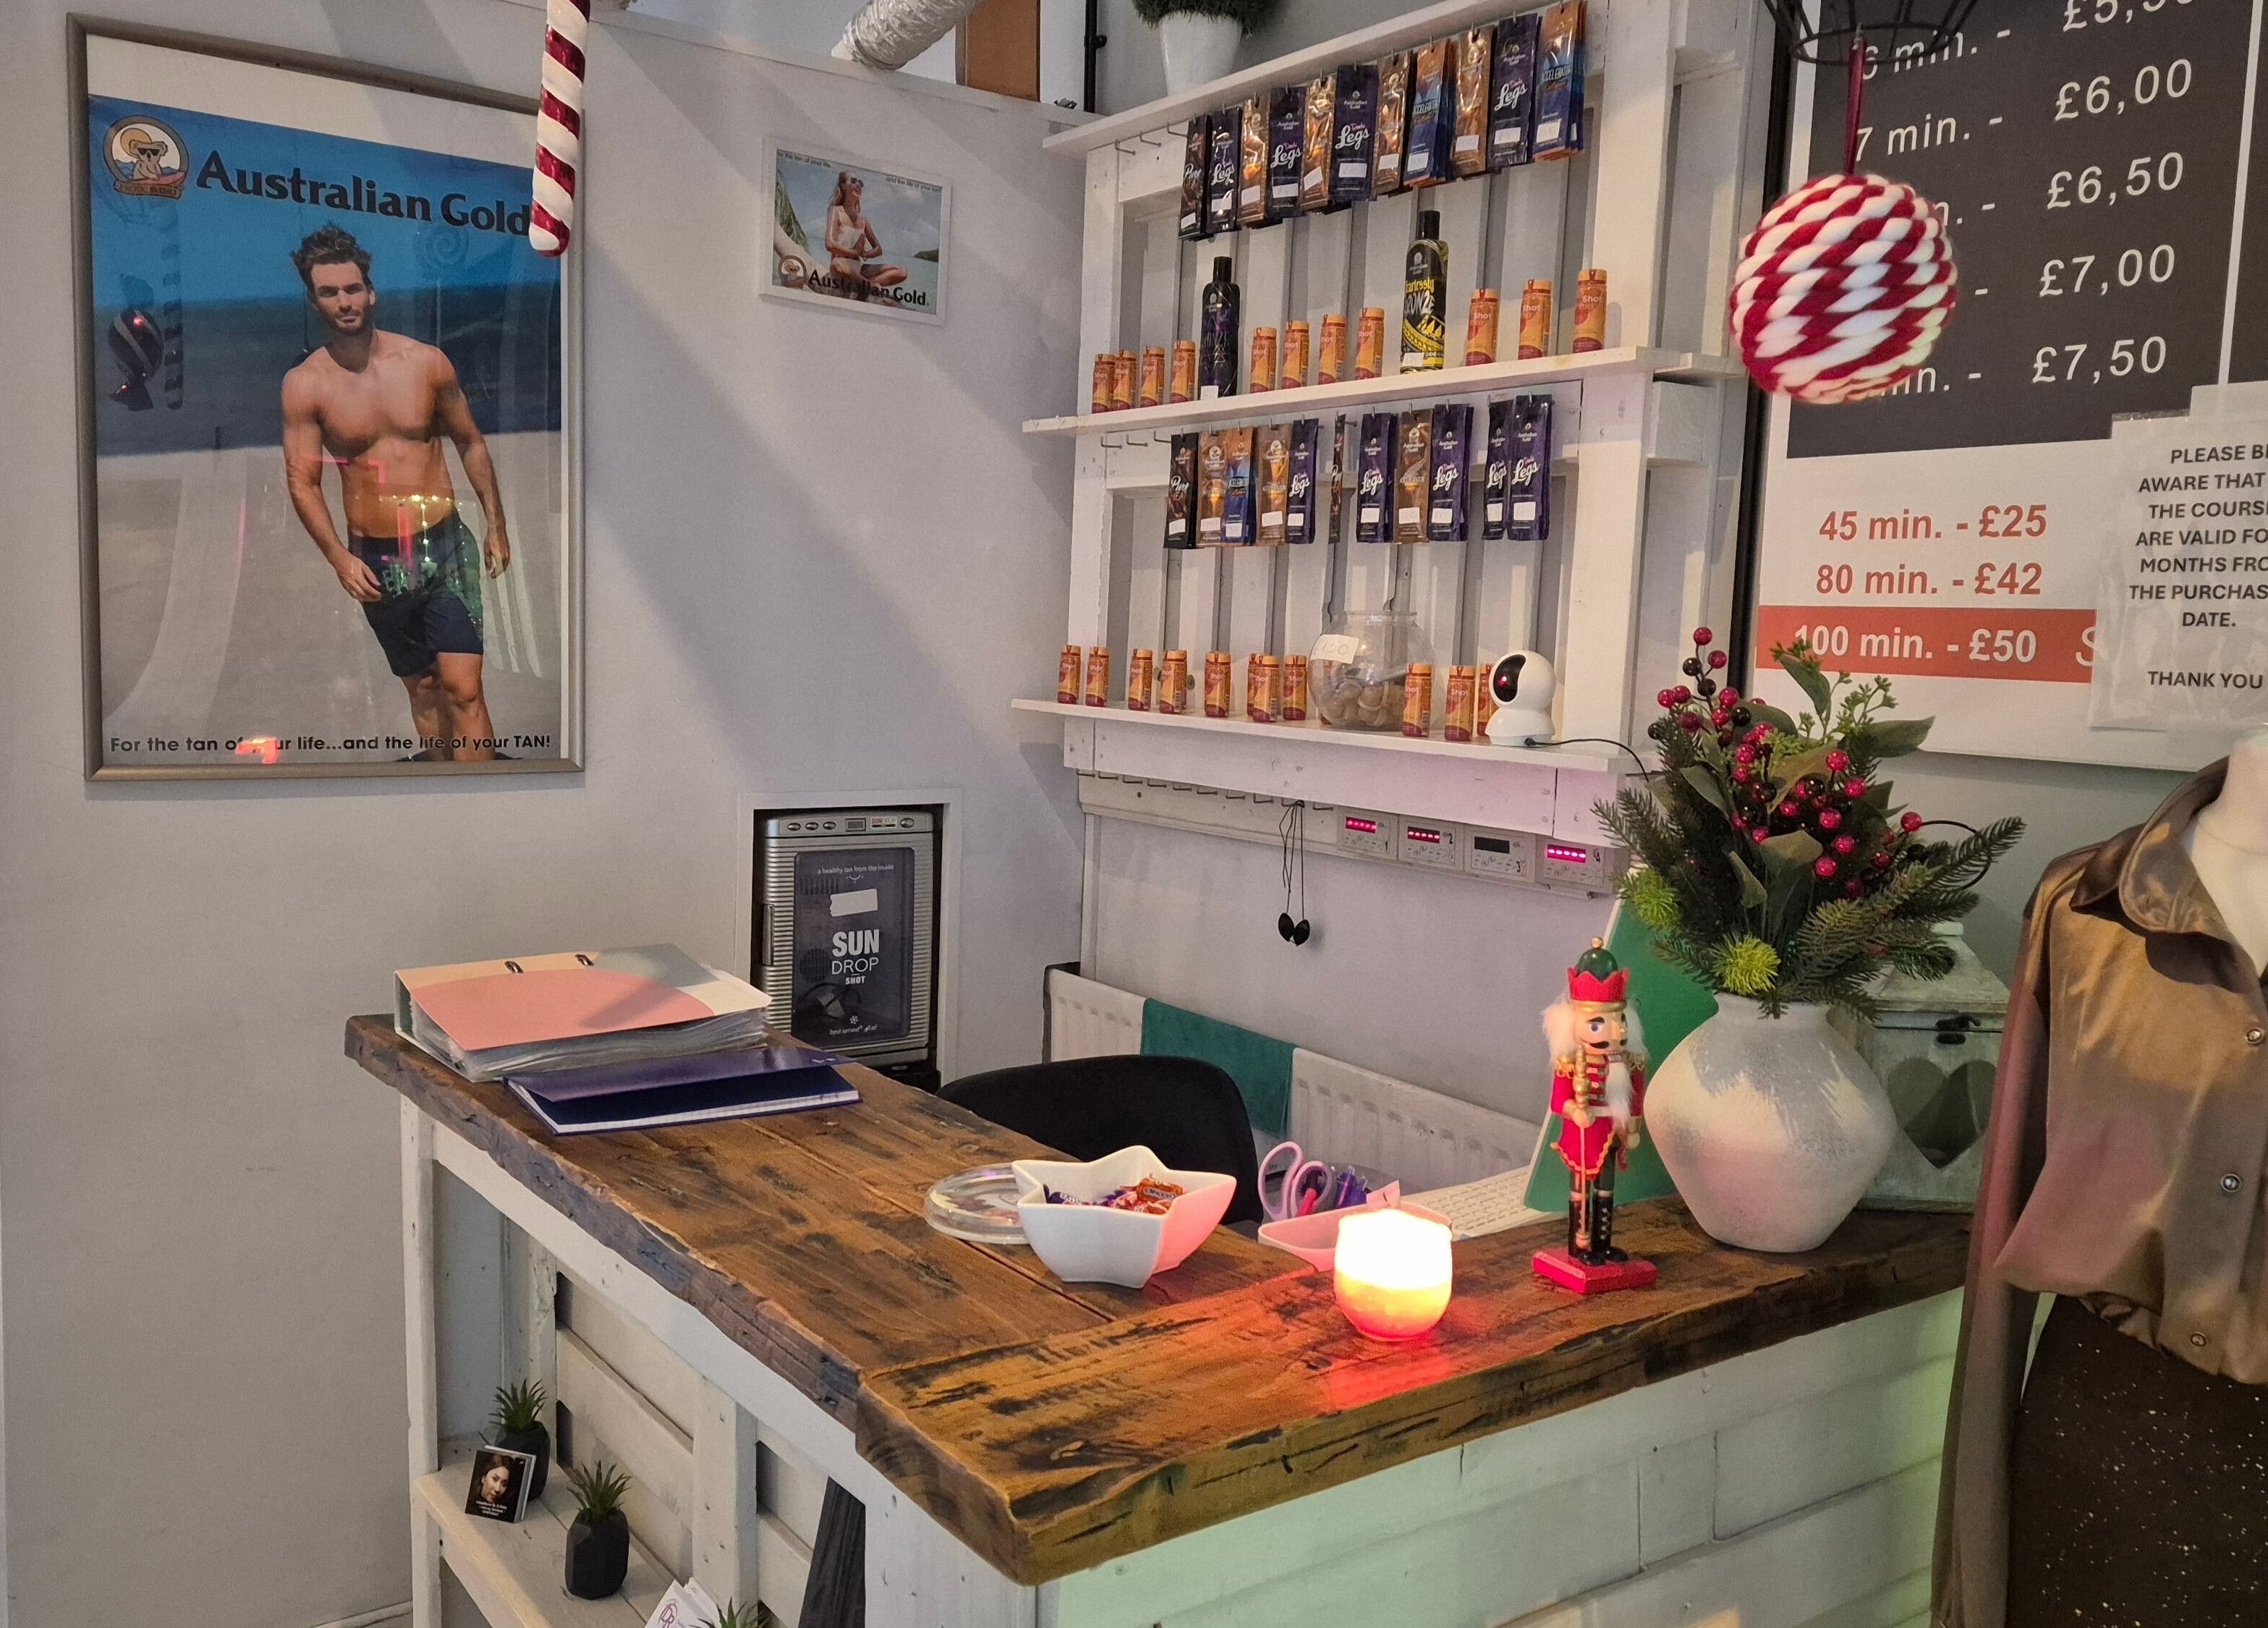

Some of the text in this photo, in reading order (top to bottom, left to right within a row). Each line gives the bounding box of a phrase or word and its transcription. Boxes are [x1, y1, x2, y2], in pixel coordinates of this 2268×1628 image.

[2063, 0, 2194, 32] £5,
[1494, 82, 1528, 111] Legs
[1855, 126, 1874, 162] 7
[1887, 113, 1970, 156] min.
[2055, 59, 2192, 122] £6,00
[1335, 124, 1370, 150] Legs
[1270, 144, 1301, 169] Legs
[196, 150, 532, 237] Australian Gold
[2047, 152, 2184, 210] £6,50
[2039, 245, 2175, 297] £7,00
[893, 287, 927, 306] Gold
[2032, 336, 2167, 385] £7,50
[2170, 444, 2268, 464] PLEASE B
[1360, 470, 1383, 496] Legs
[1432, 466, 1458, 491] Legs
[1487, 464, 1507, 490] Legs
[1511, 459, 1541, 486] Legs
[2138, 472, 2266, 493] AWARE THAT
[1288, 474, 1310, 498] Legs
[1819, 511, 1857, 541] 45
[1869, 508, 1942, 540] min.
[1978, 504, 2047, 538] £25
[2149, 500, 2268, 520] THE COURS
[2136, 531, 2174, 546] ARE
[2178, 529, 2237, 546] VALID
[2140, 556, 2227, 573] MONTHS
[1816, 564, 1853, 595] 80
[1864, 564, 1938, 595] min.
[1974, 562, 2043, 595] £42
[2129, 585, 2166, 600] THE
[2182, 611, 2236, 627] DATE.
[1860, 627, 1932, 659] min.
[1969, 628, 2037, 664] £50
[2148, 671, 2263, 689] THANK YOU
[111, 737, 140, 752] For
[148, 737, 179, 752] the
[186, 737, 218, 751] tan
[385, 736, 413, 749] the
[420, 736, 445, 749] life
[451, 735, 467, 748] of
[472, 737, 509, 751] your
[514, 734, 550, 748] TAN!
[832, 929, 880, 957] SUN
[832, 957, 879, 975] DROP
[845, 975, 866, 985] SHOT
